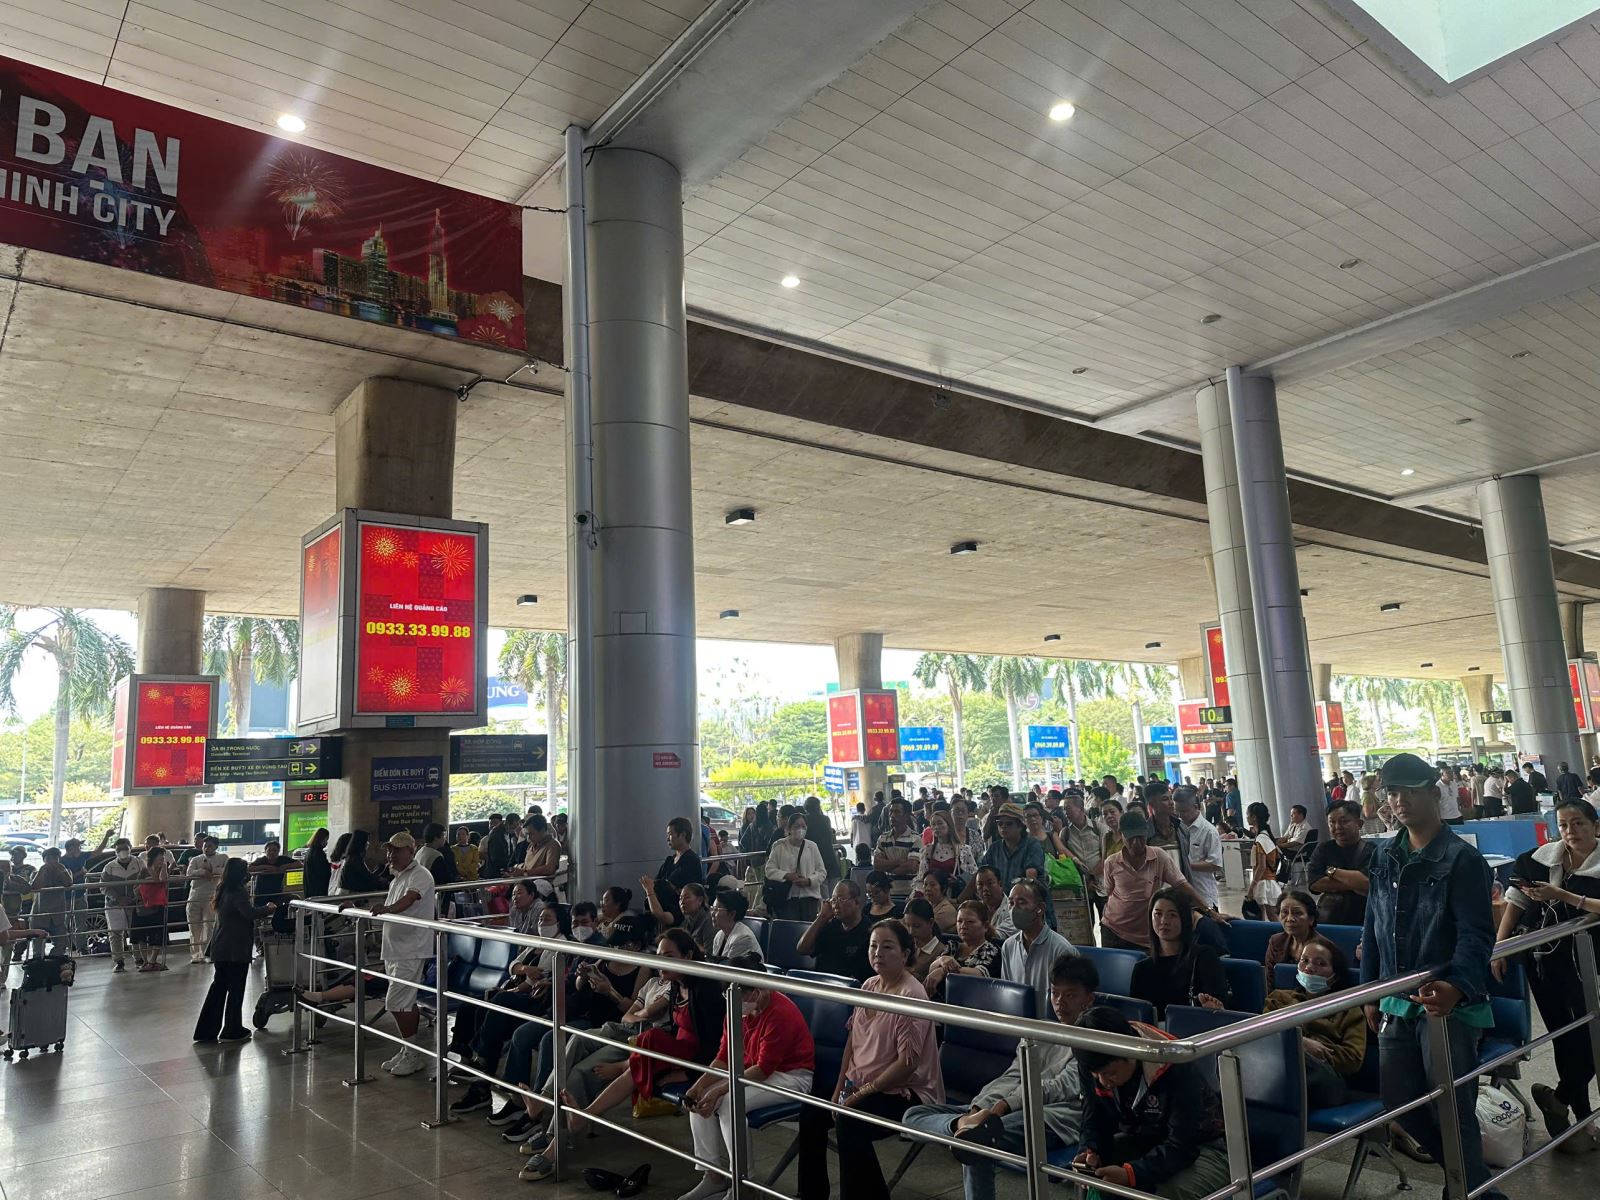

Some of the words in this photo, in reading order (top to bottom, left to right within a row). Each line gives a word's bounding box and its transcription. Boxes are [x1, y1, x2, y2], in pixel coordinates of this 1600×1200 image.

[15, 95, 180, 197] BẠN
[93, 192, 176, 236] CITY
[366, 621, 471, 638] 0933.33.99.88
[1200, 709, 1216, 722] 10
[1481, 713, 1494, 722] 11
[140, 736, 206, 744] 0933.33.99.88
[401, 768, 410, 776] XE
[410, 767, 424, 776] BUÝT
[391, 782, 425, 791] STATION
